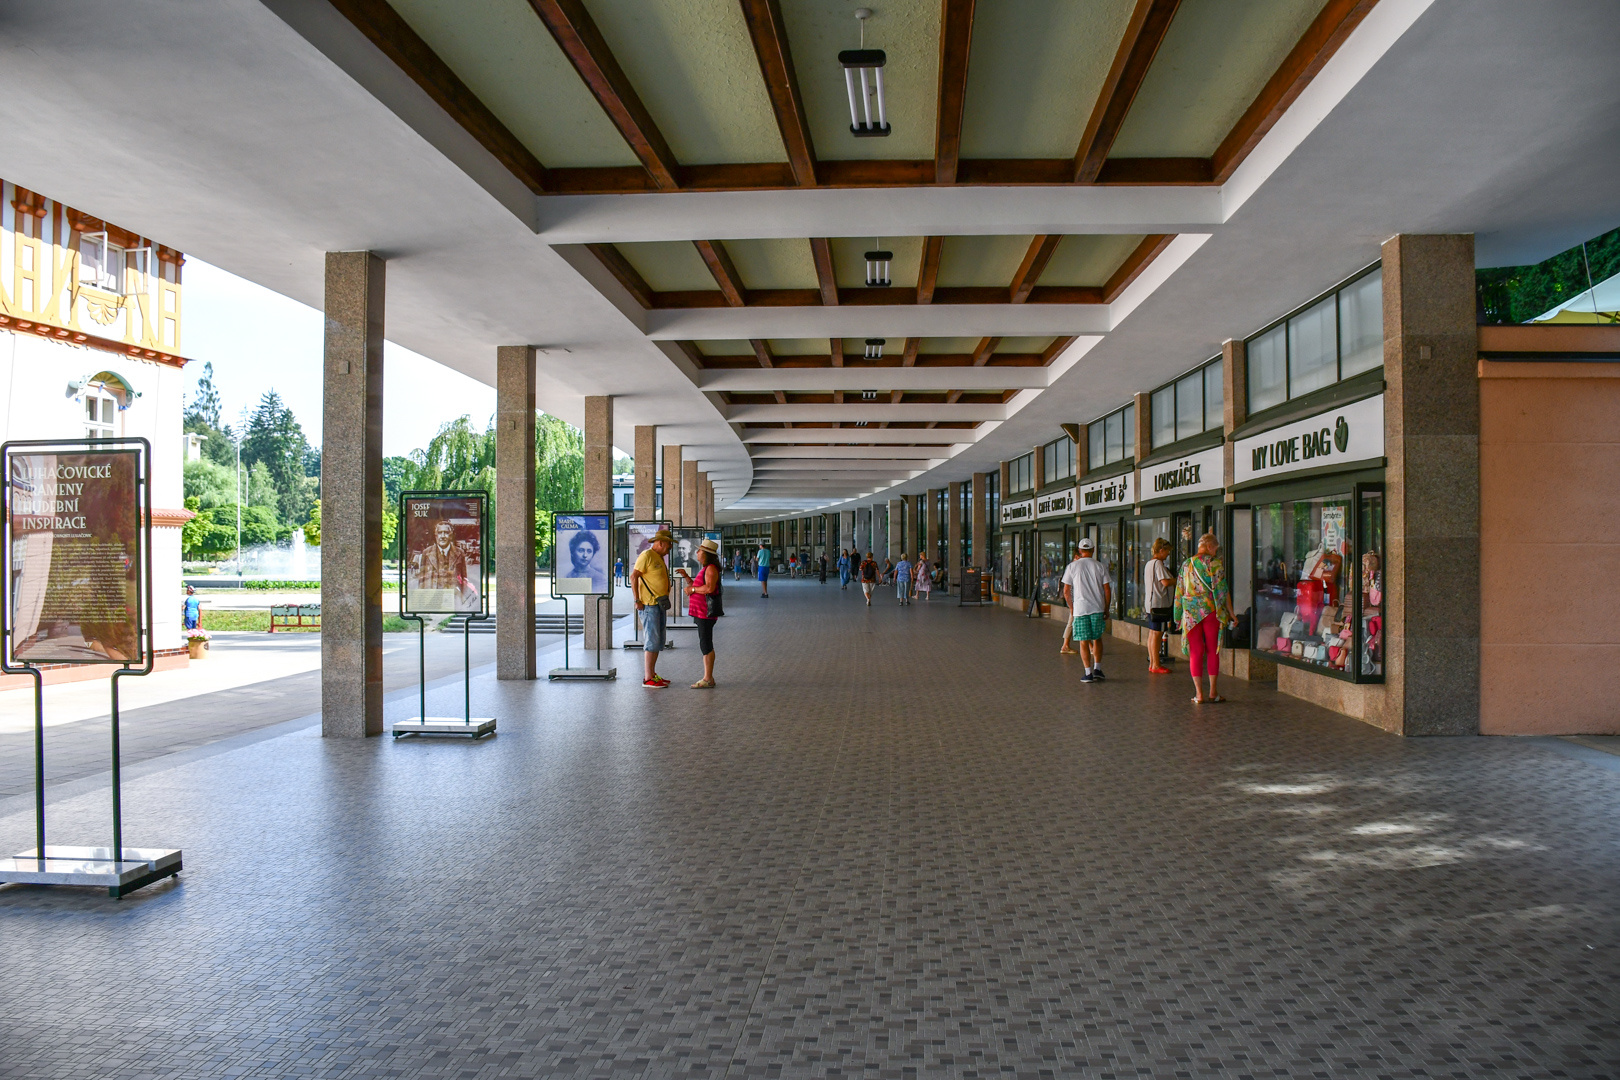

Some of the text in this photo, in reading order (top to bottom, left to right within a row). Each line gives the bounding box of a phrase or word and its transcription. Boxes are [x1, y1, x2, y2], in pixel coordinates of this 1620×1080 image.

[1252, 427, 1331, 471] MY LOVE BAG
[22, 463, 112, 479] LUHAČOVICKÉ
[1154, 461, 1201, 492] LOUSKÁČEK
[22, 483, 84, 496] PRAMENY
[22, 498, 79, 513] HUDEBNÍ
[411, 503, 430, 511] JOSEF
[22, 516, 87, 530] INSPIRACE
